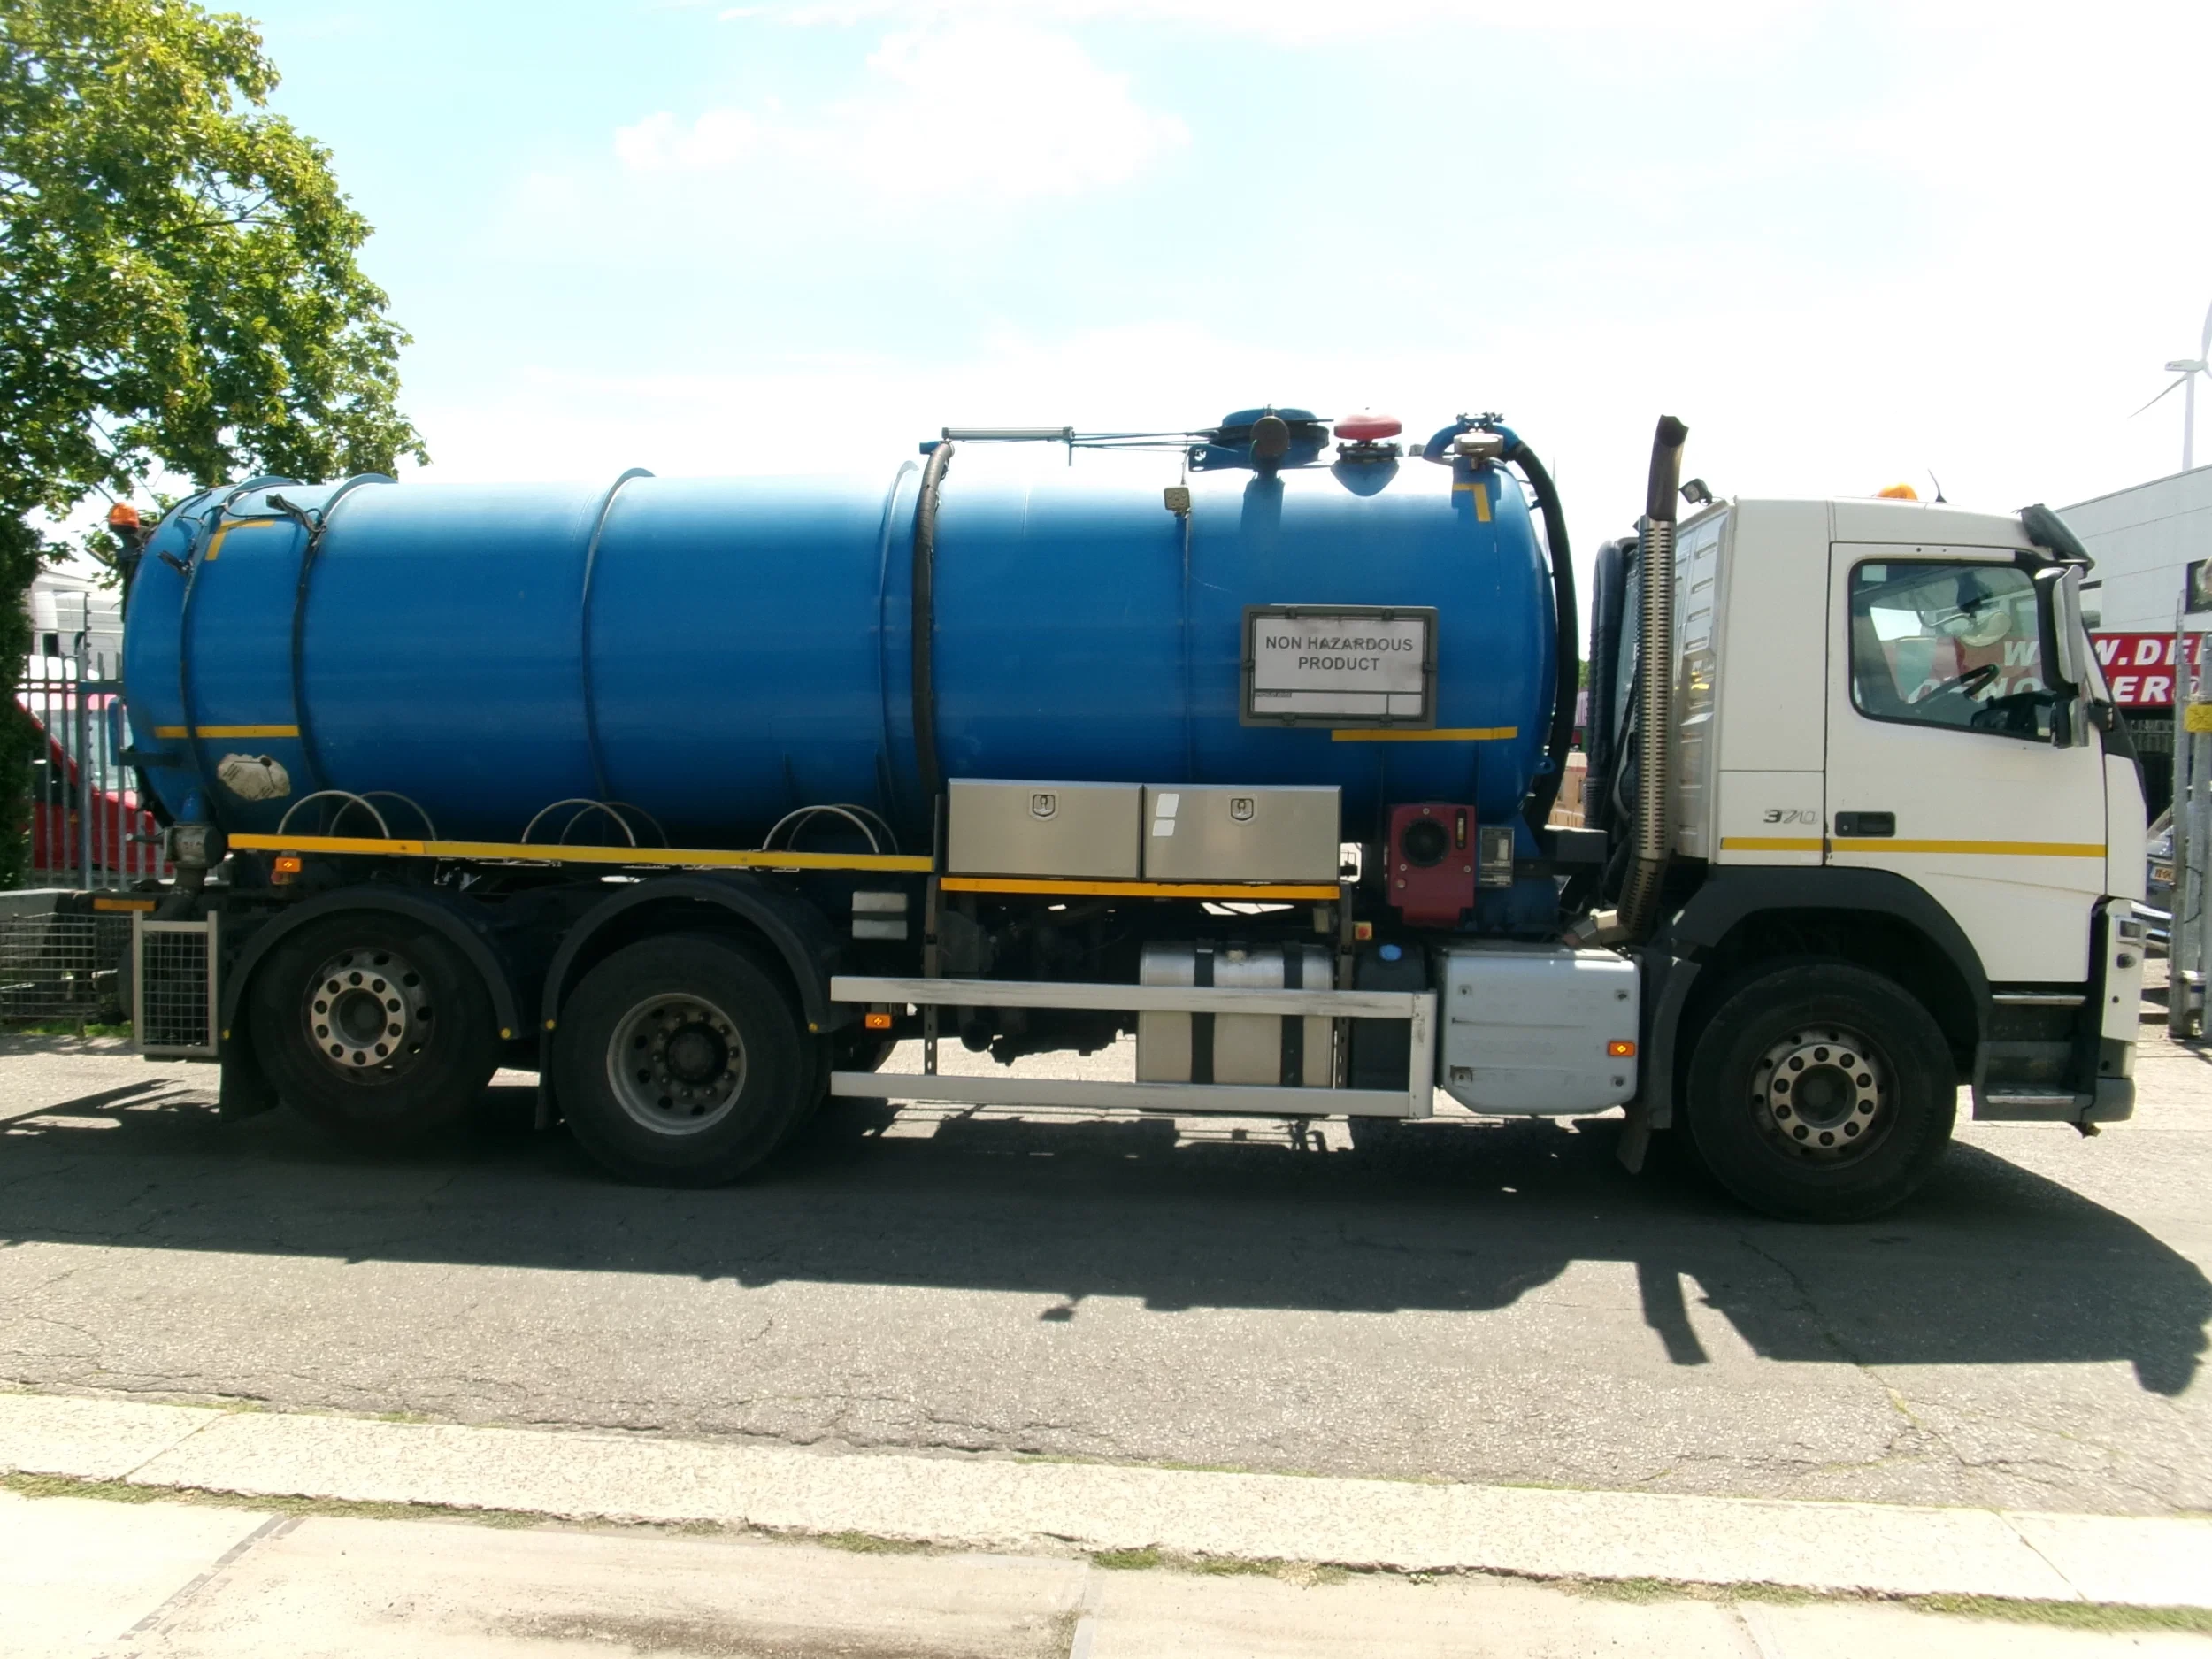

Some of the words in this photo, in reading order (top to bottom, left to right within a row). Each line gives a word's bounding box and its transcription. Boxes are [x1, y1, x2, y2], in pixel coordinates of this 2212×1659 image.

[1265, 636, 1302, 649] NON
[1307, 637, 1413, 652] HAZARDOUS
[1298, 657, 1380, 671] PRODUCT
[1763, 809, 1818, 825] 370
